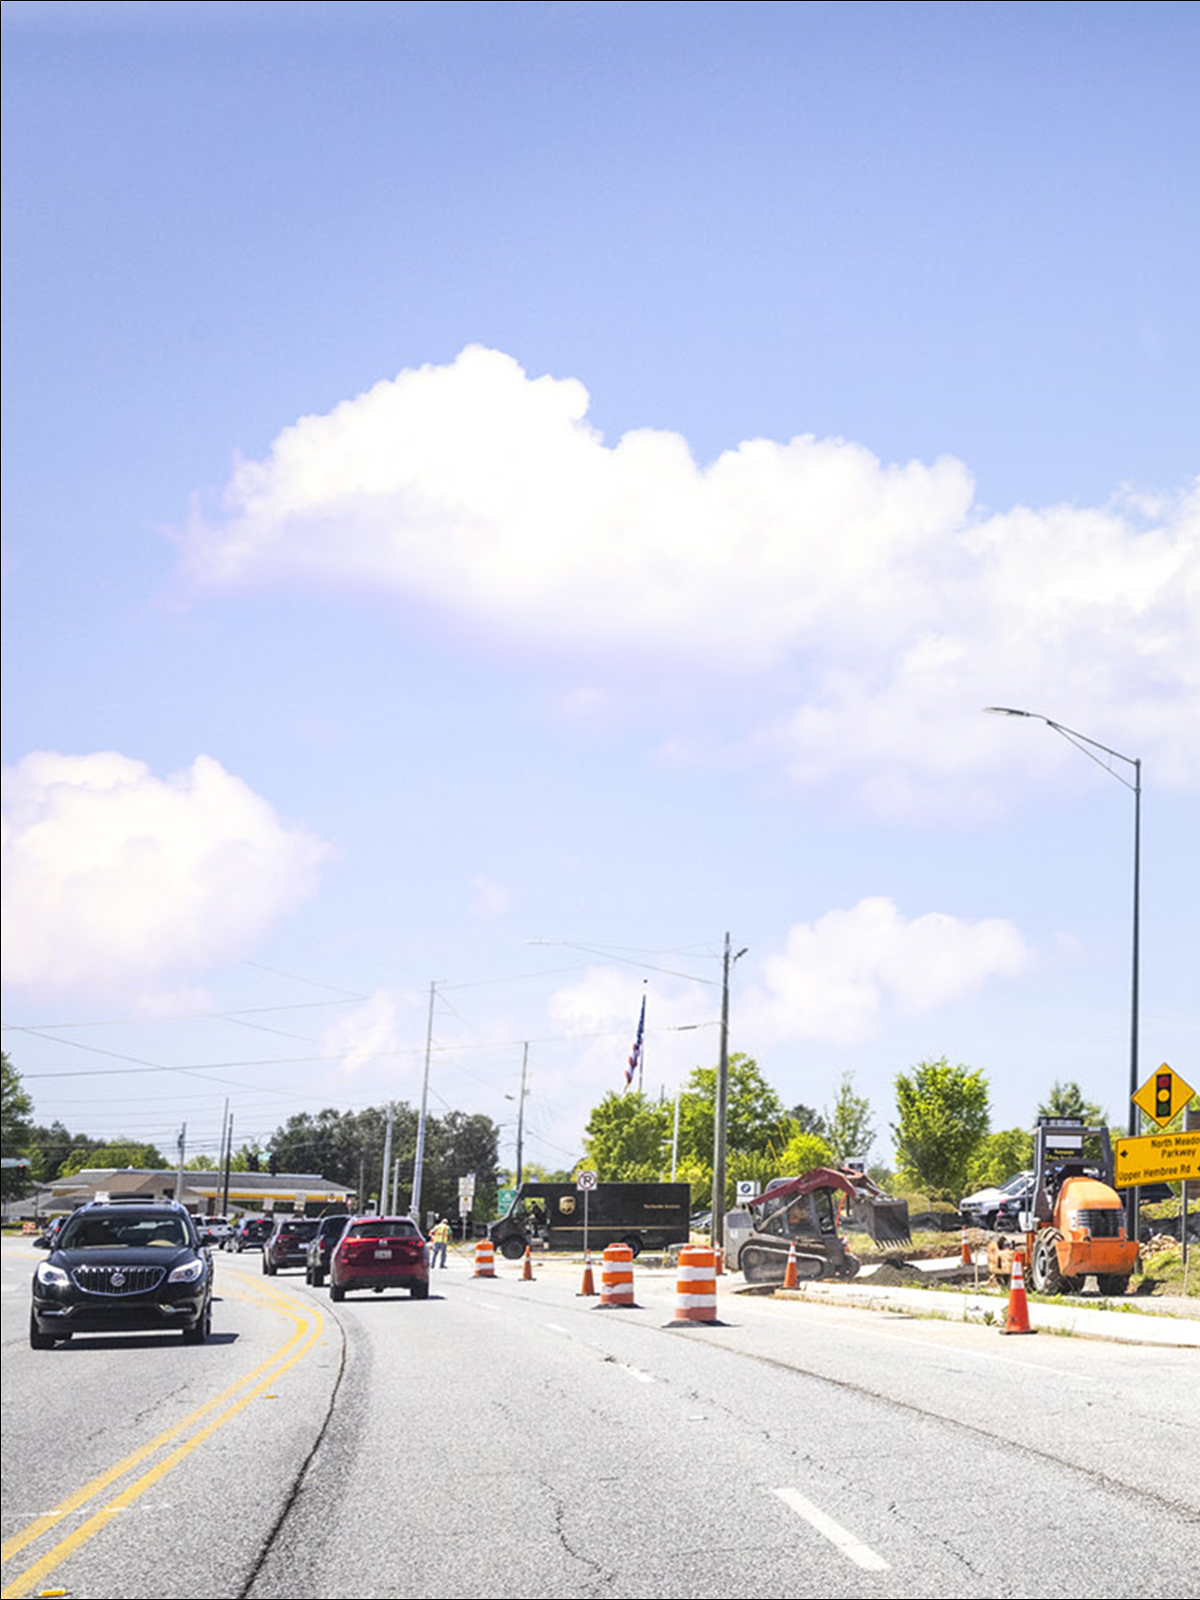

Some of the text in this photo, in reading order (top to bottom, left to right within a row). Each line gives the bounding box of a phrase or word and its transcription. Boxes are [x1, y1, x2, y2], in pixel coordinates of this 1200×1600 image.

[1151, 1138, 1173, 1149] North
[1161, 1148, 1197, 1159] Parkway
[1118, 1164, 1191, 1182] Upper Hembree Rd
